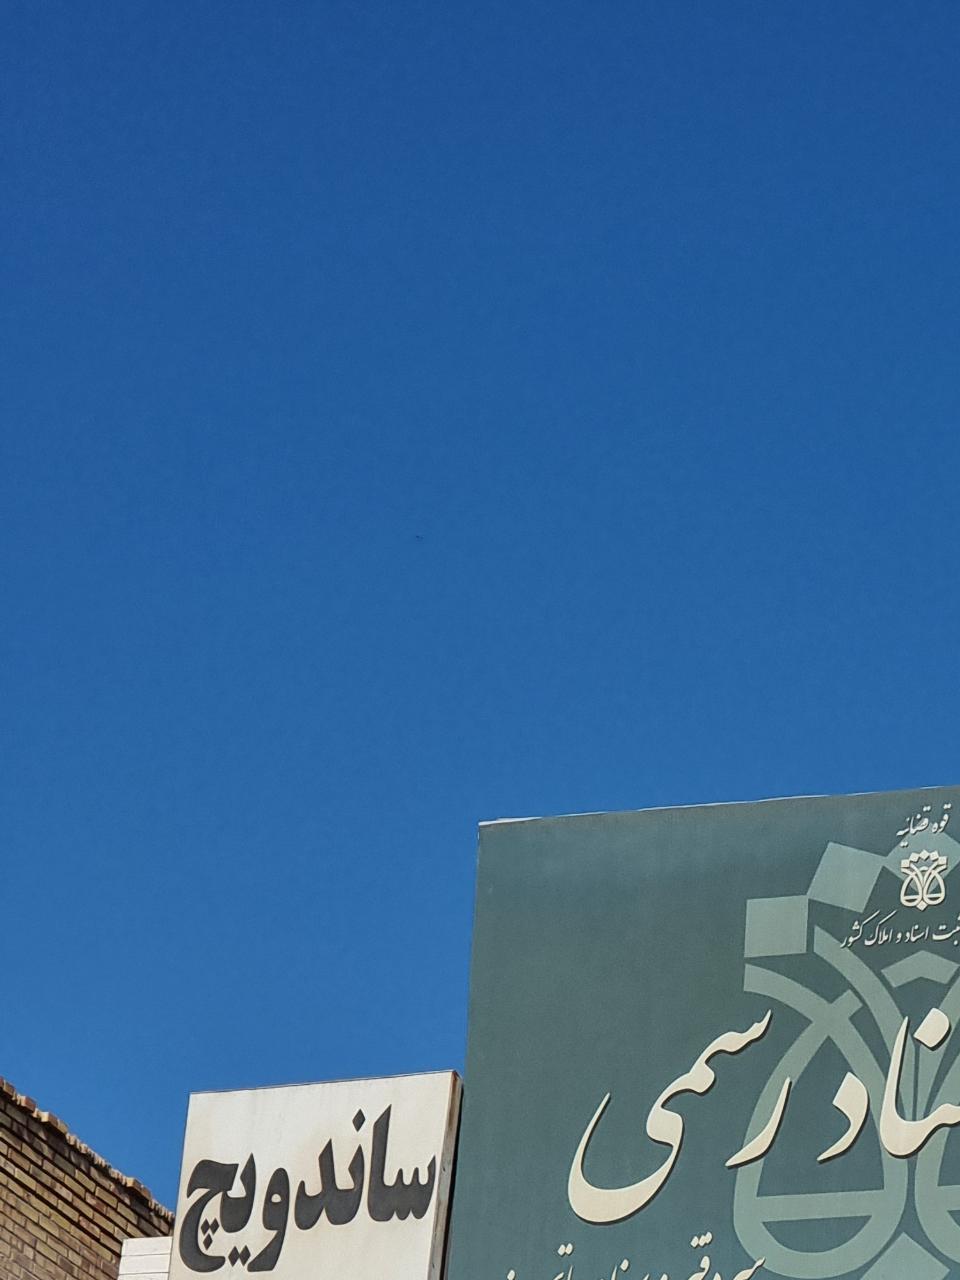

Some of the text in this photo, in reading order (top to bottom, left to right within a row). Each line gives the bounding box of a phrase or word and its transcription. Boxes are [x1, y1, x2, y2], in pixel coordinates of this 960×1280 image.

[931, 803, 952, 833] قوه
[840, 910, 881, 948] کشور
[864, 909, 898, 946] املاک
[894, 932, 902, 944] و
[904, 924, 929, 943] اسناد
[567, 1008, 794, 1225] رسمی
[178, 1103, 437, 1274] ساندویچ
